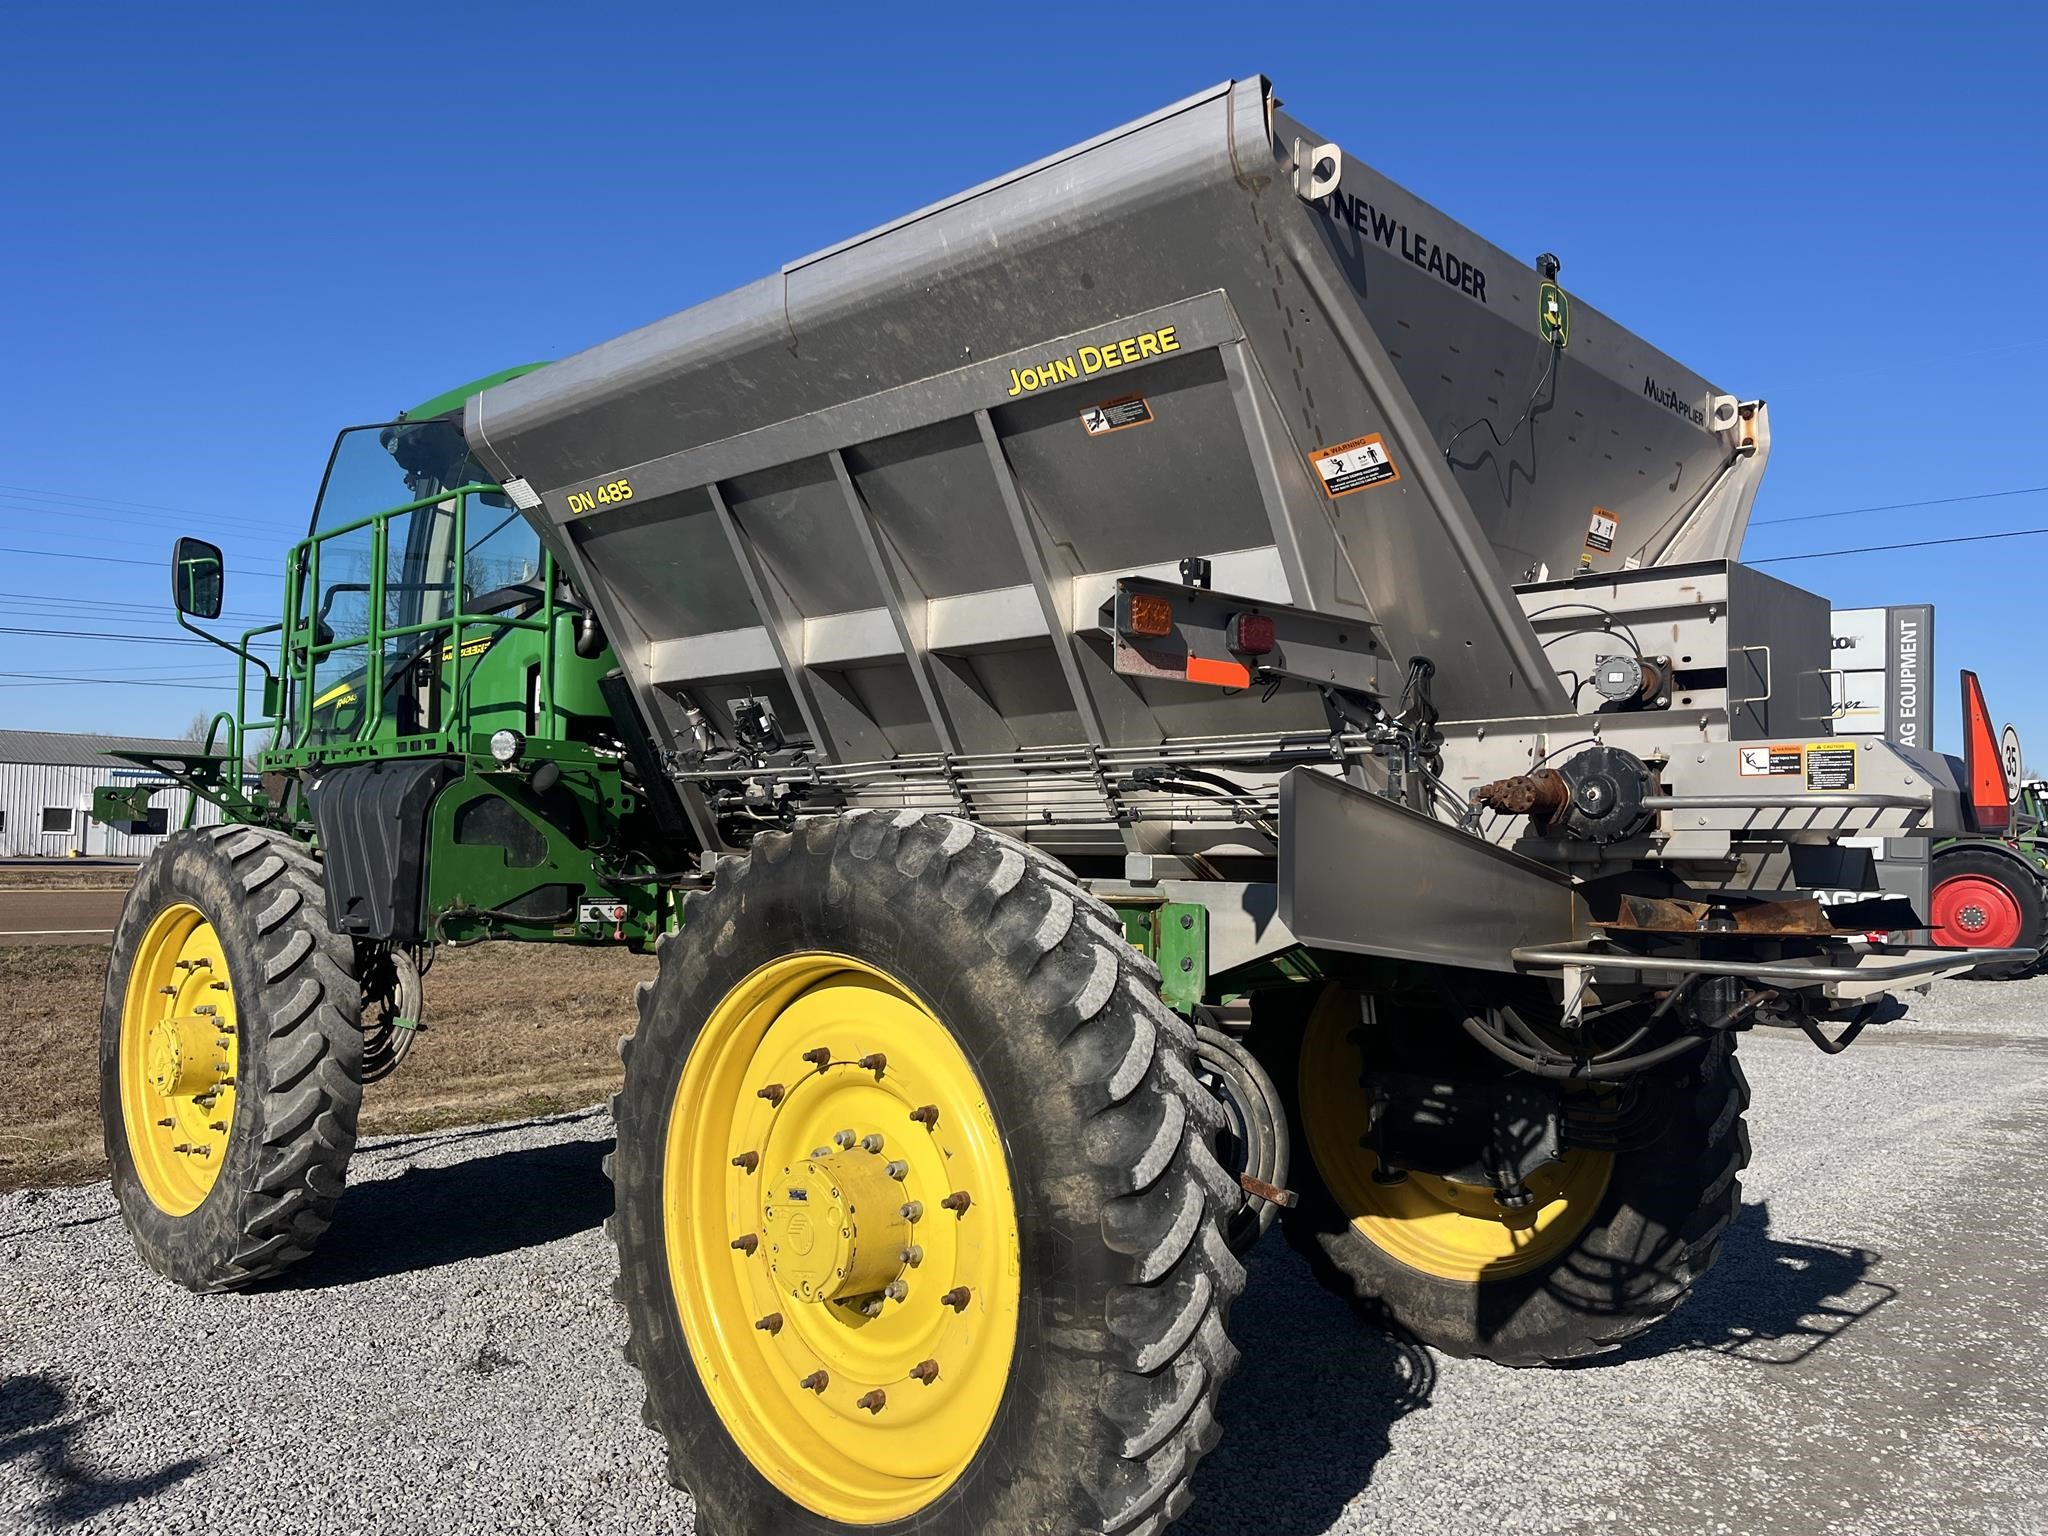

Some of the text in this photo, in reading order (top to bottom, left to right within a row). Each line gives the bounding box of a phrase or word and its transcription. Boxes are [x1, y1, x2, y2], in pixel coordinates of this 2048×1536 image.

[1332, 188, 1487, 303] NEW LEADER
[1007, 325, 1181, 397] JOHN DEERE
[1330, 438, 1367, 454] WARNING
[567, 490, 597, 514] DN
[597, 479, 634, 504] 485
[1899, 619, 1917, 748] AG EQUIPMENT
[2006, 745, 2017, 778] 35
